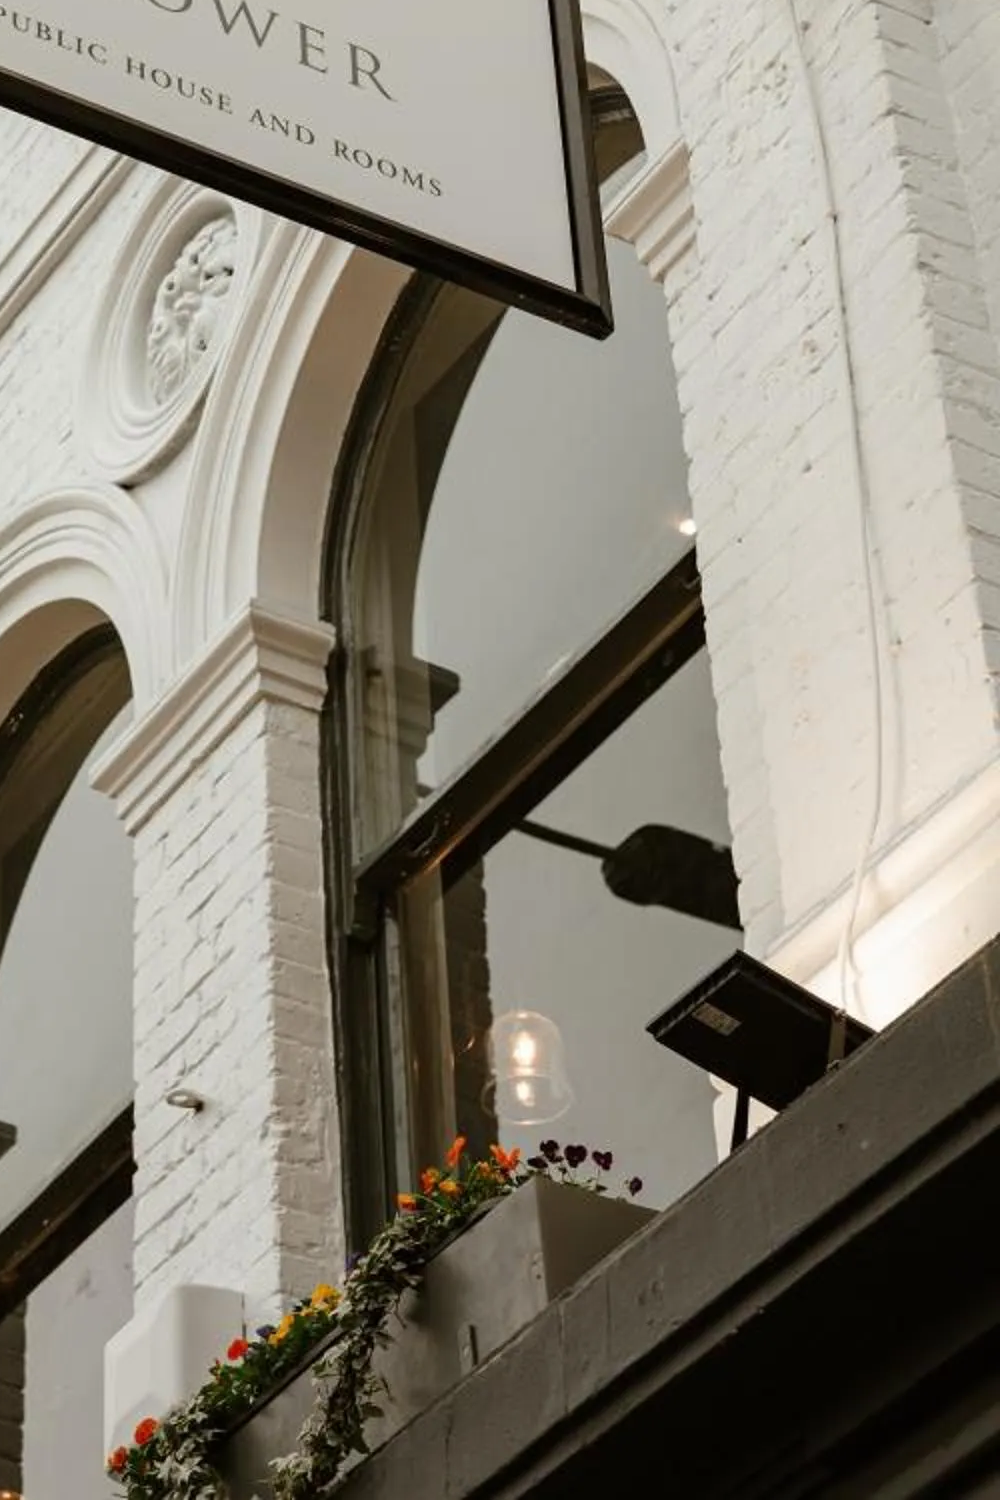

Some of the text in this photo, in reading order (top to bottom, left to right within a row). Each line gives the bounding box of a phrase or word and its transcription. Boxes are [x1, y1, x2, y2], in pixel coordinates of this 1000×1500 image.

[125, 56, 234, 116] HOUSE
[248, 108, 317, 147] AND
[333, 139, 443, 198] ROOMS
